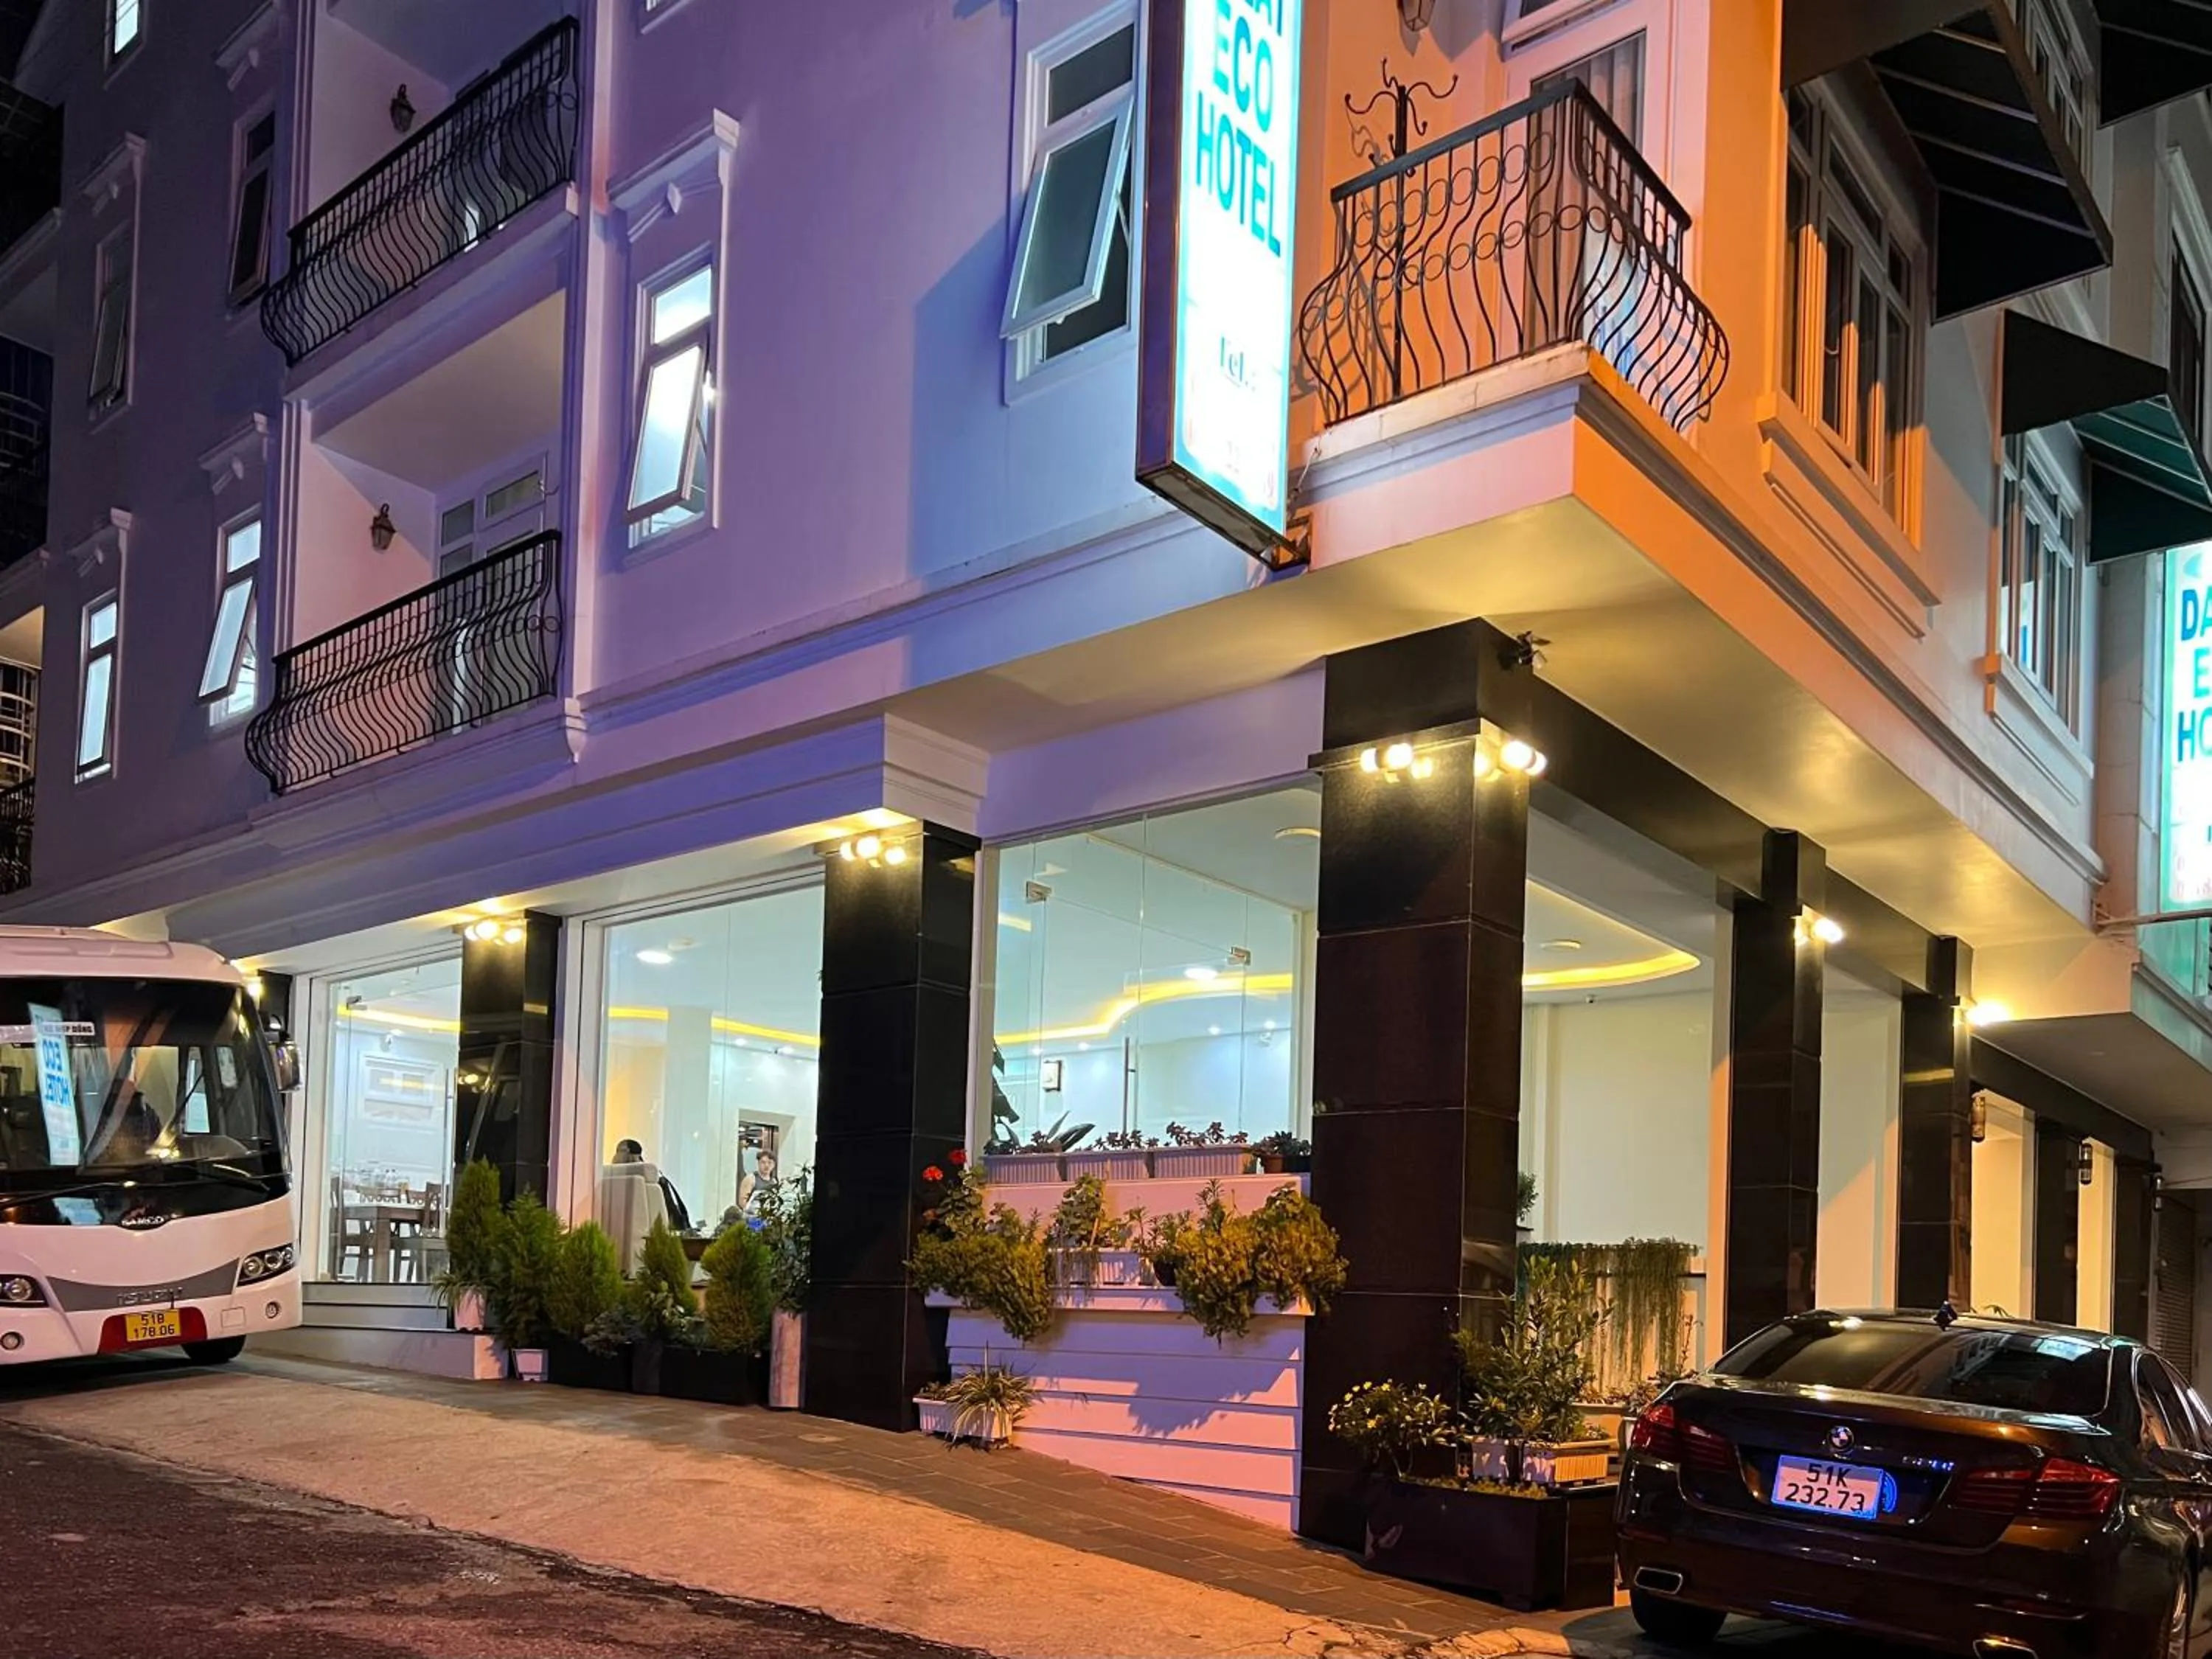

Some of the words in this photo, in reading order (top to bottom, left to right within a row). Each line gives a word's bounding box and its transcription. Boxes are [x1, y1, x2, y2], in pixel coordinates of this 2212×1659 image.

[1214, 0, 1273, 132] ECO
[1197, 90, 1281, 257] HOTEL
[1784, 1482, 1865, 1512] 232.73
[1806, 1462, 1850, 1487] 51K
